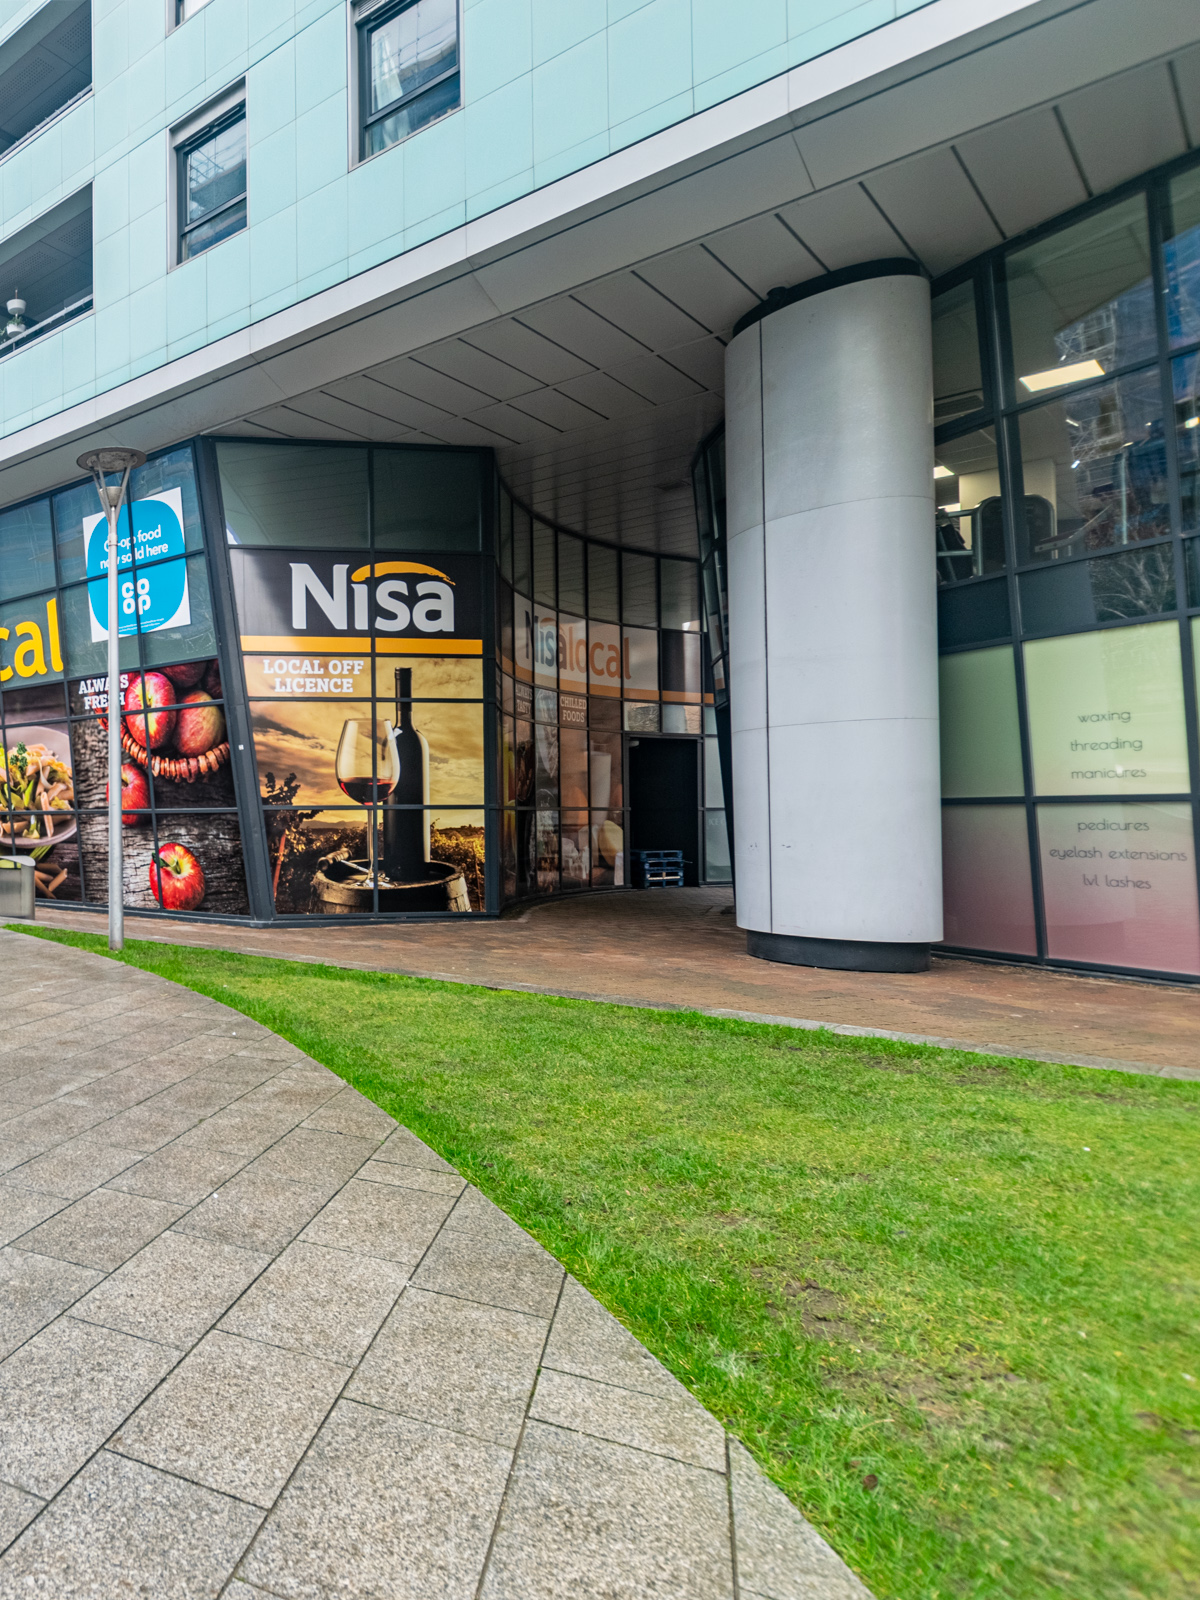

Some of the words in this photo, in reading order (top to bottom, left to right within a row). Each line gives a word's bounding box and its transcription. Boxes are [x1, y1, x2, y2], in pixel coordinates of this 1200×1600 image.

[104, 534, 137, 552] C-op
[137, 524, 161, 543] food
[146, 542, 169, 557] here
[288, 561, 455, 633] Nisa
[263, 659, 324, 675] LOCAL
[328, 659, 364, 675] OFF
[78, 674, 129, 694] ALWAS
[274, 677, 354, 693] LICENCE
[84, 691, 126, 710] FREH
[560, 696, 587, 710] CHILLED
[562, 709, 585, 723] FOODS
[1077, 711, 1131, 723] waxing
[1070, 737, 1143, 751] threading
[1071, 767, 1147, 779] manicures
[1077, 818, 1150, 832] pedicures
[1049, 846, 1102, 860] eyelash
[1108, 848, 1188, 861] extensions
[1105, 874, 1152, 889] lashes
